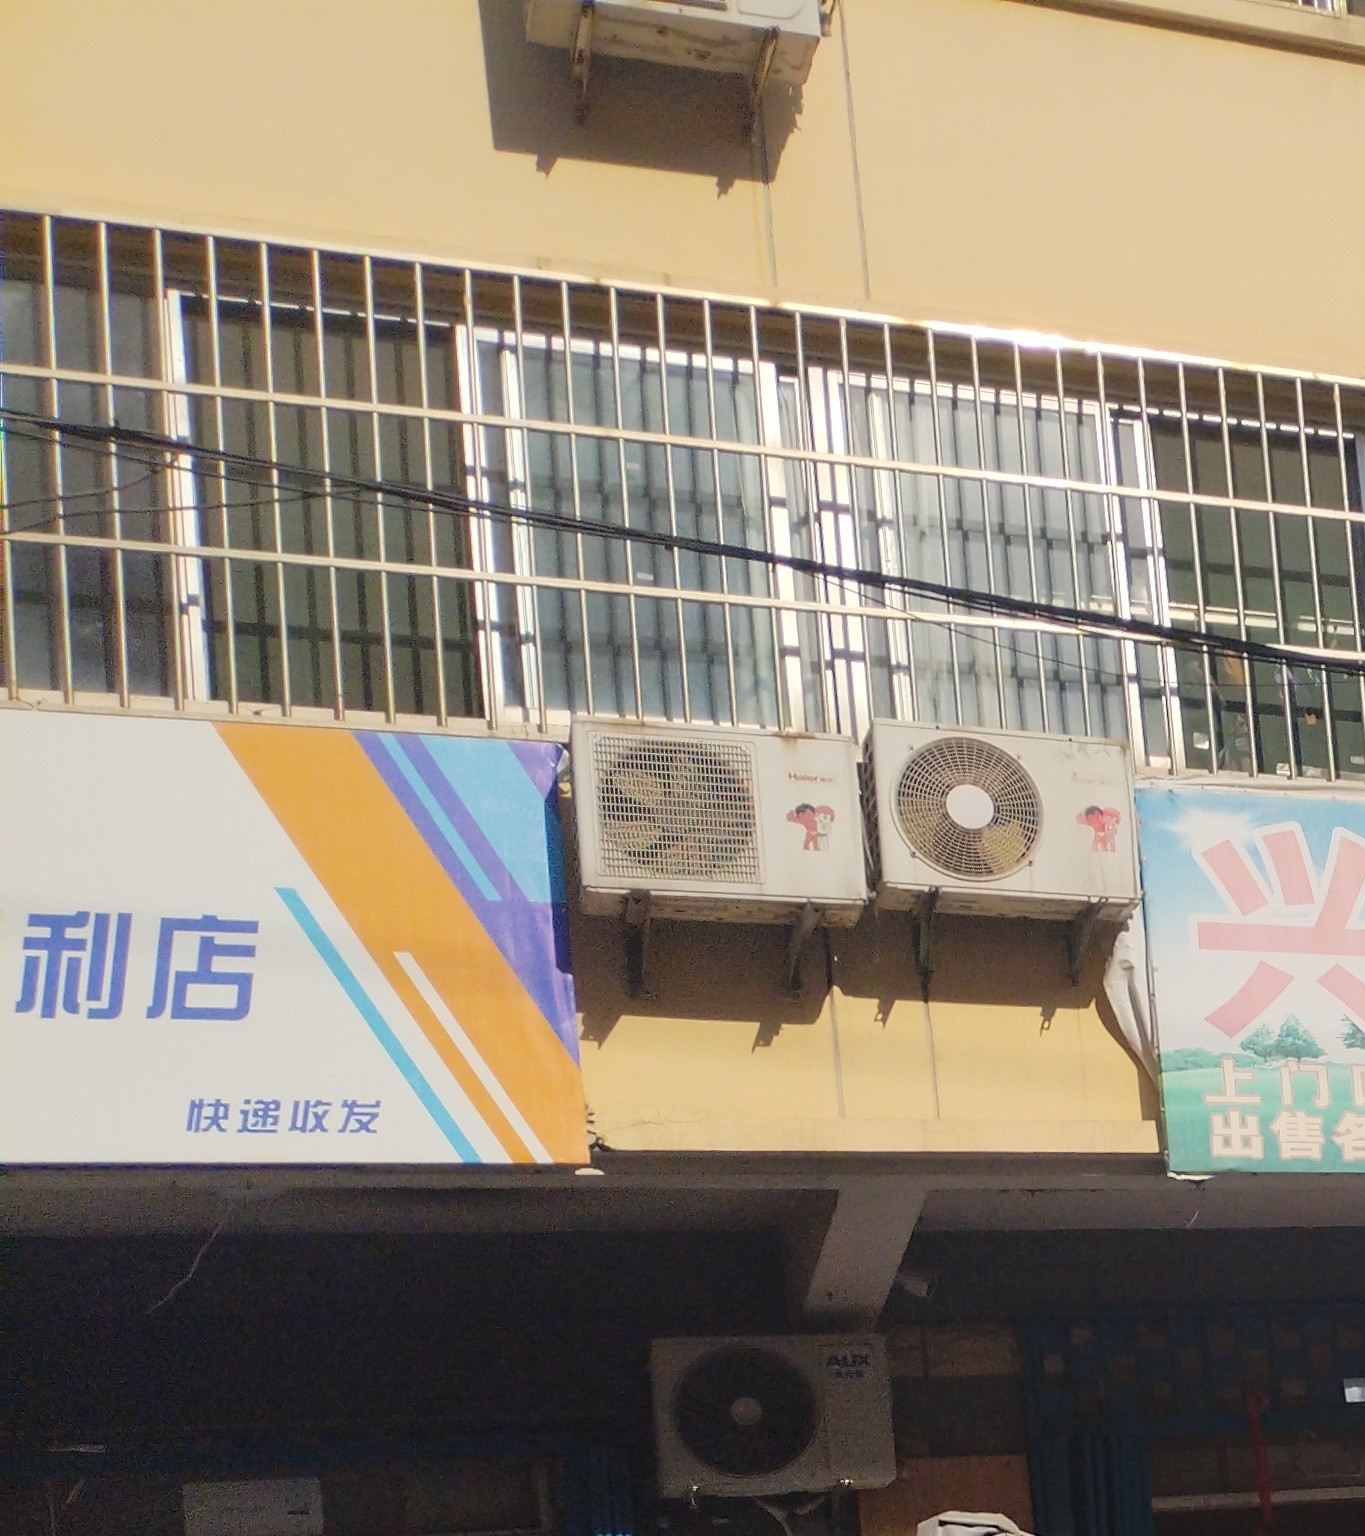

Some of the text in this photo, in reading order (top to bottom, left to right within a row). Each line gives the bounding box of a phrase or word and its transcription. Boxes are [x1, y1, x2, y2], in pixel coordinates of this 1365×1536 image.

[15, 911, 260, 1022] 利店
[186, 1098, 382, 1136] 快递收发
[826, 1352, 871, 1368] AUX
